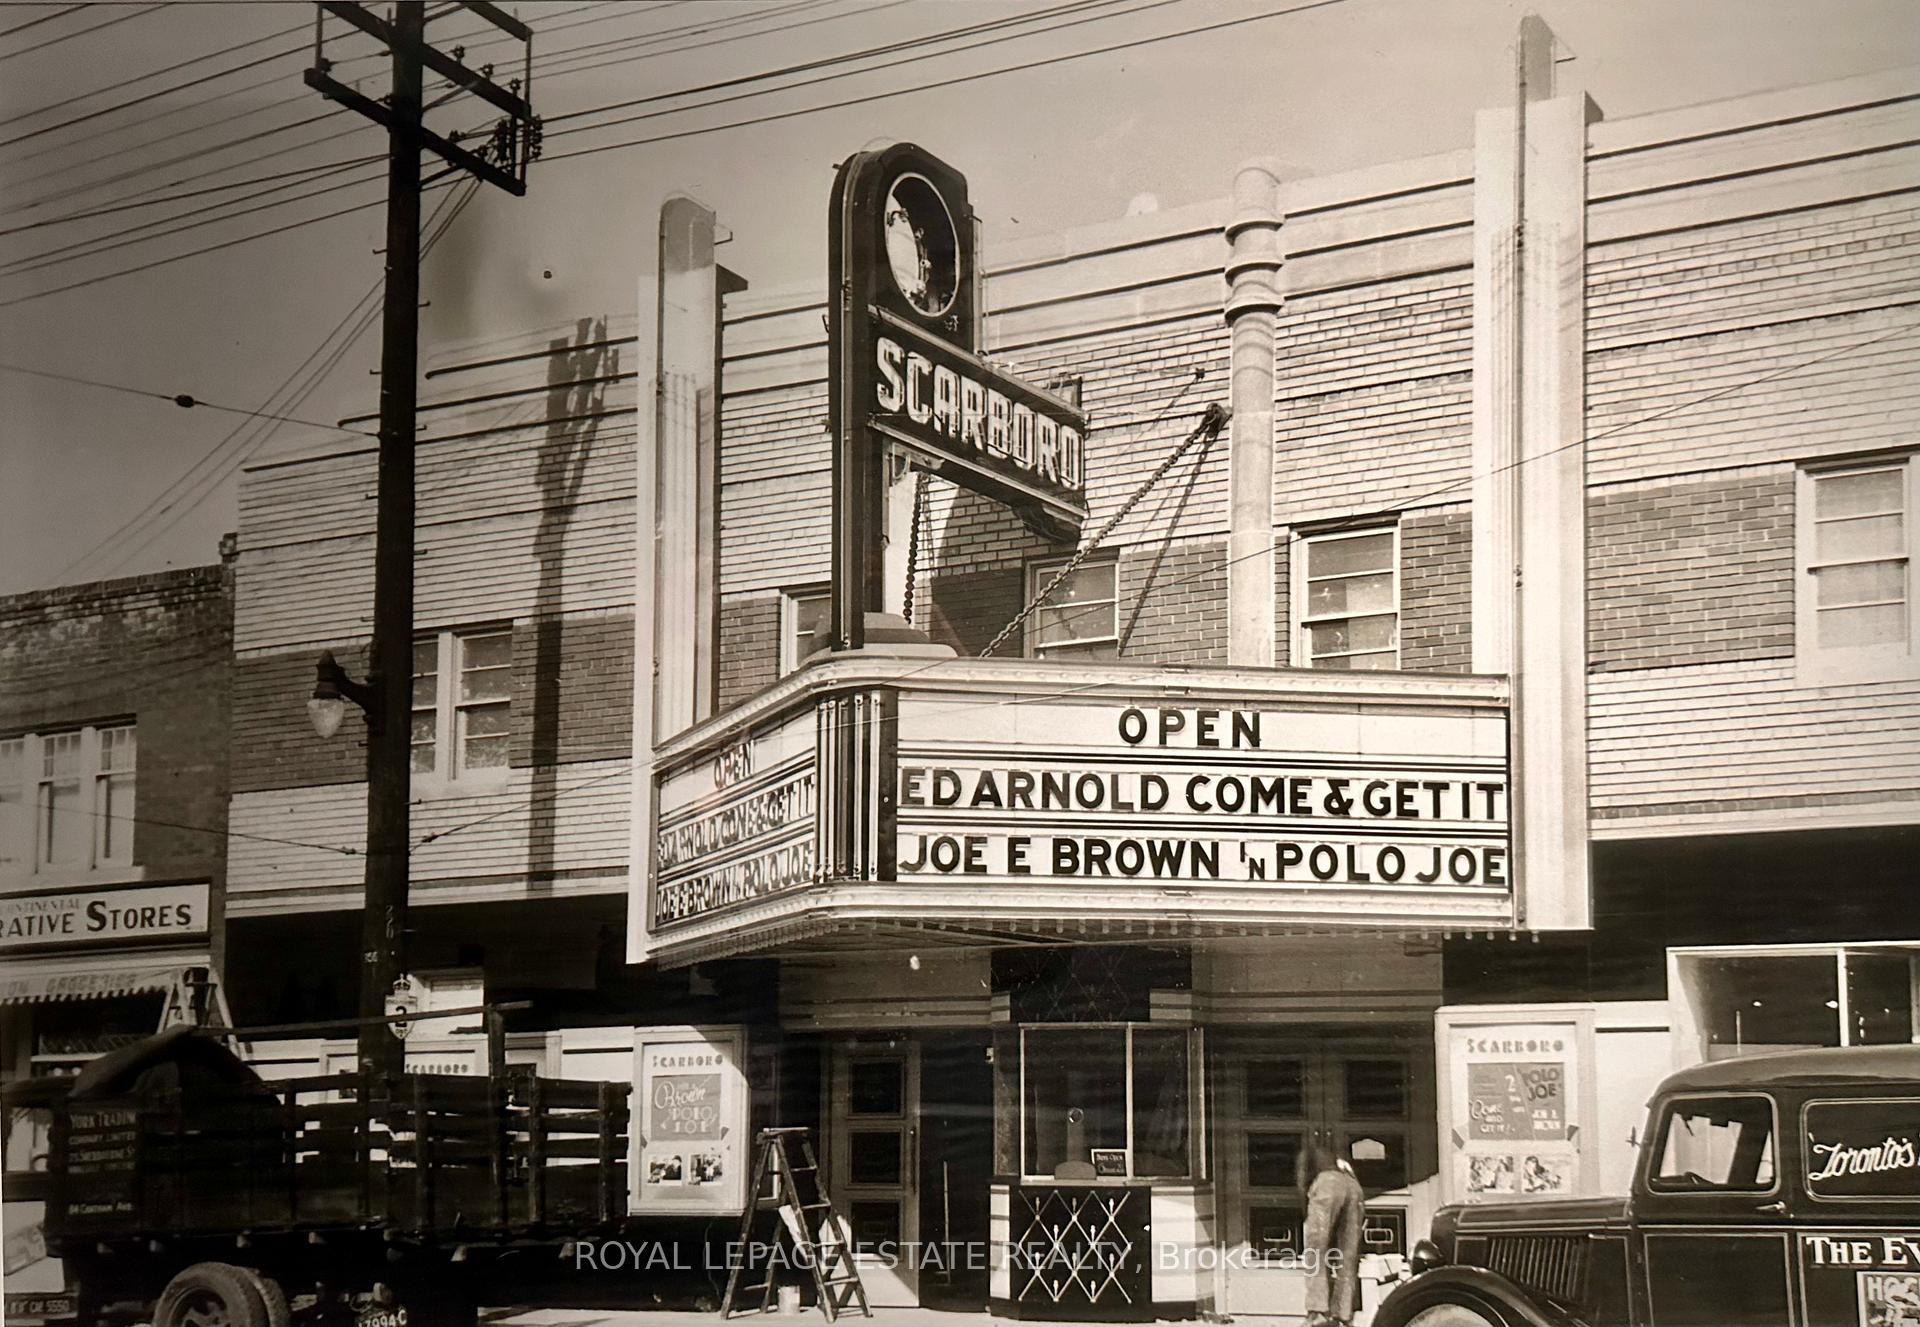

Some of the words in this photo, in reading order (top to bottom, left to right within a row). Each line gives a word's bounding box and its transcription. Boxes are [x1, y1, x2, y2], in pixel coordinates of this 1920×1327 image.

[877, 337, 1084, 490] SCARBORO
[1118, 708, 1260, 747] OPEN
[714, 741, 753, 789] OPEN
[902, 769, 962, 805] ED
[971, 770, 1169, 811] ARNOLD
[1186, 776, 1312, 814] COME
[1324, 779, 1353, 815] &
[1363, 781, 1449, 818] GET
[1462, 783, 1504, 819] IT
[900, 835, 988, 873] JOE
[1008, 837, 1031, 873] E
[1053, 838, 1219, 878] BROWN
[1276, 843, 1406, 882] POLO
[1415, 847, 1506, 884] JOE
[86, 901, 192, 932] STORES
[1467, 1039, 1564, 1053] SCARBORO
[1528, 1083, 1557, 1101] JOE
[1806, 1237, 1872, 1264] THE
